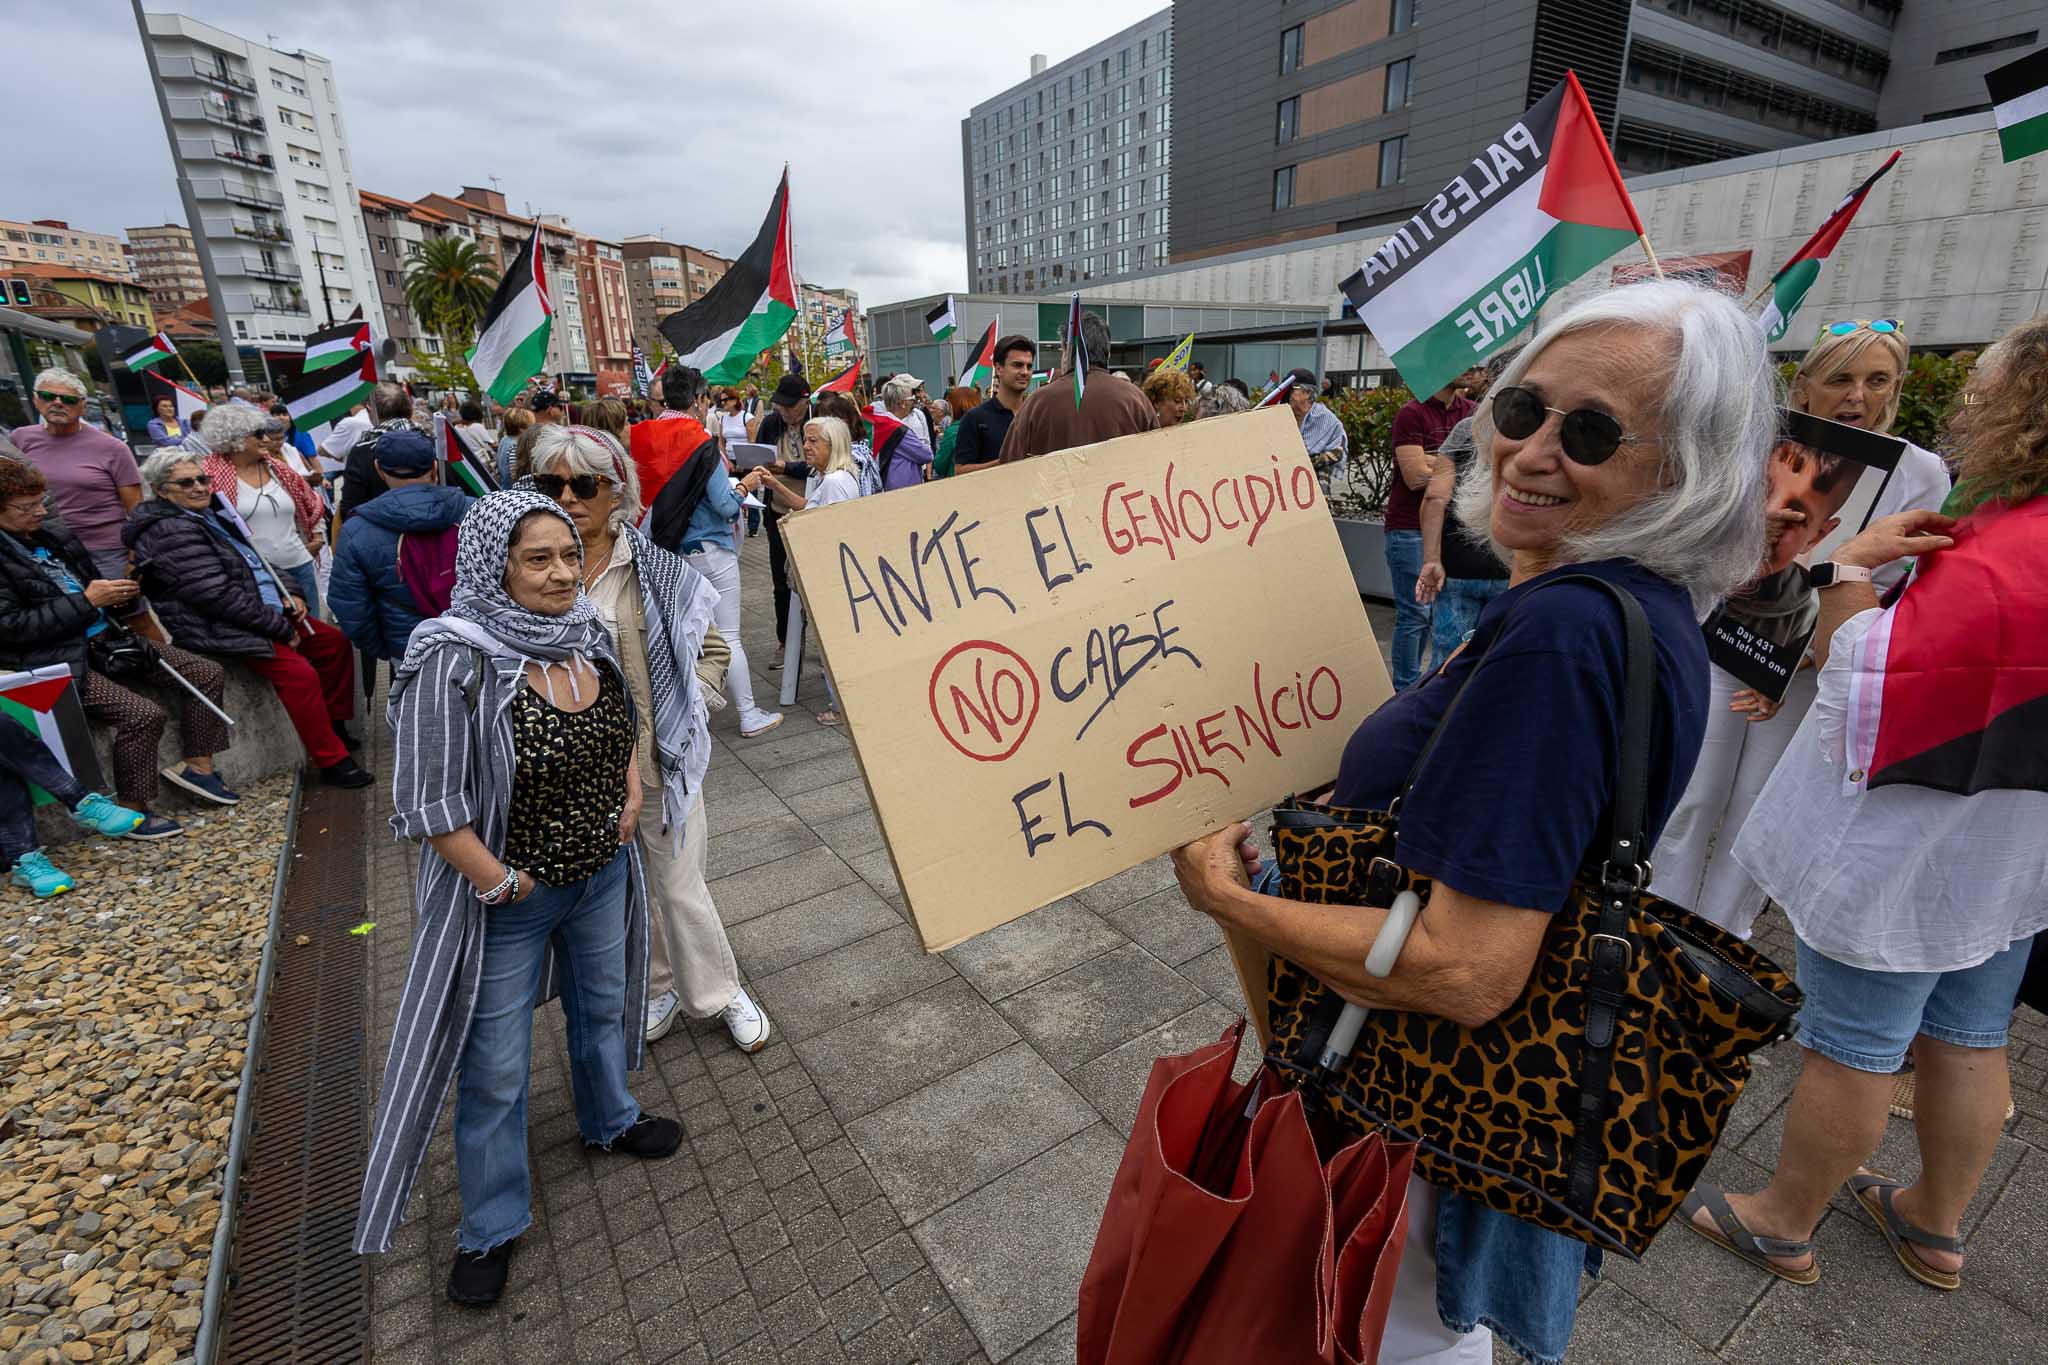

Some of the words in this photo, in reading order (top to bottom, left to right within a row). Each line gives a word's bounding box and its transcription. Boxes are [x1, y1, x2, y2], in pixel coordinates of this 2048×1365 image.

[839, 510, 1017, 636] ANTE
[1025, 505, 1093, 592] EL
[1101, 455, 1316, 560] GENOCIDIO
[950, 658, 1025, 743] NO
[1050, 600, 1202, 741] CABE
[1716, 627, 1735, 645] Pain
[1736, 640, 1753, 656] left
[1754, 652, 1766, 664] no
[1768, 661, 1787, 676] one
[1737, 626, 1754, 643] Day
[1756, 638, 1774, 654] 431
[1013, 772, 1113, 858] EL
[1126, 662, 1342, 808] SILENCIO
